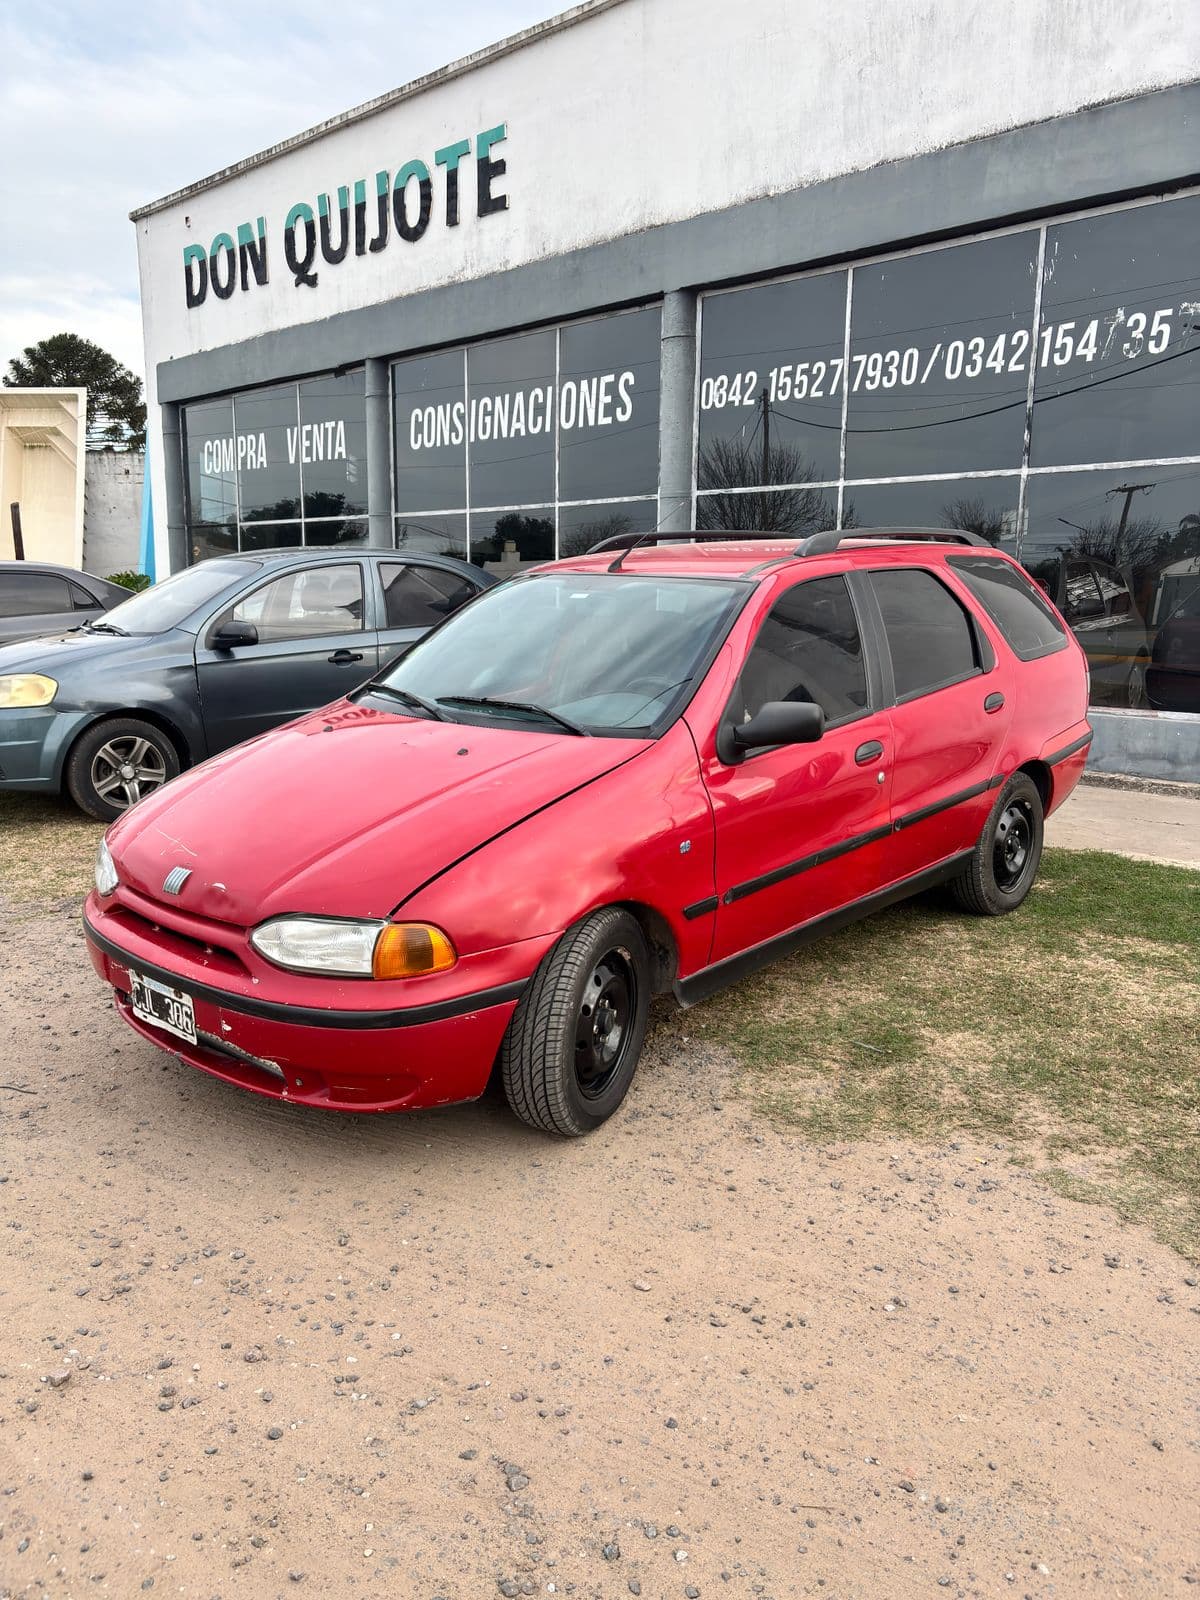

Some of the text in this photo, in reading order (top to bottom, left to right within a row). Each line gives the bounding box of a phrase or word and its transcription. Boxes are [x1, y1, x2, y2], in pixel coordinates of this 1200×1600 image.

[183, 122, 510, 309] DON QUIJOTE
[410, 371, 635, 450] CONSIGNACIONES
[701, 371, 758, 410] 0342
[204, 420, 347, 475] COMPRA VENTA
